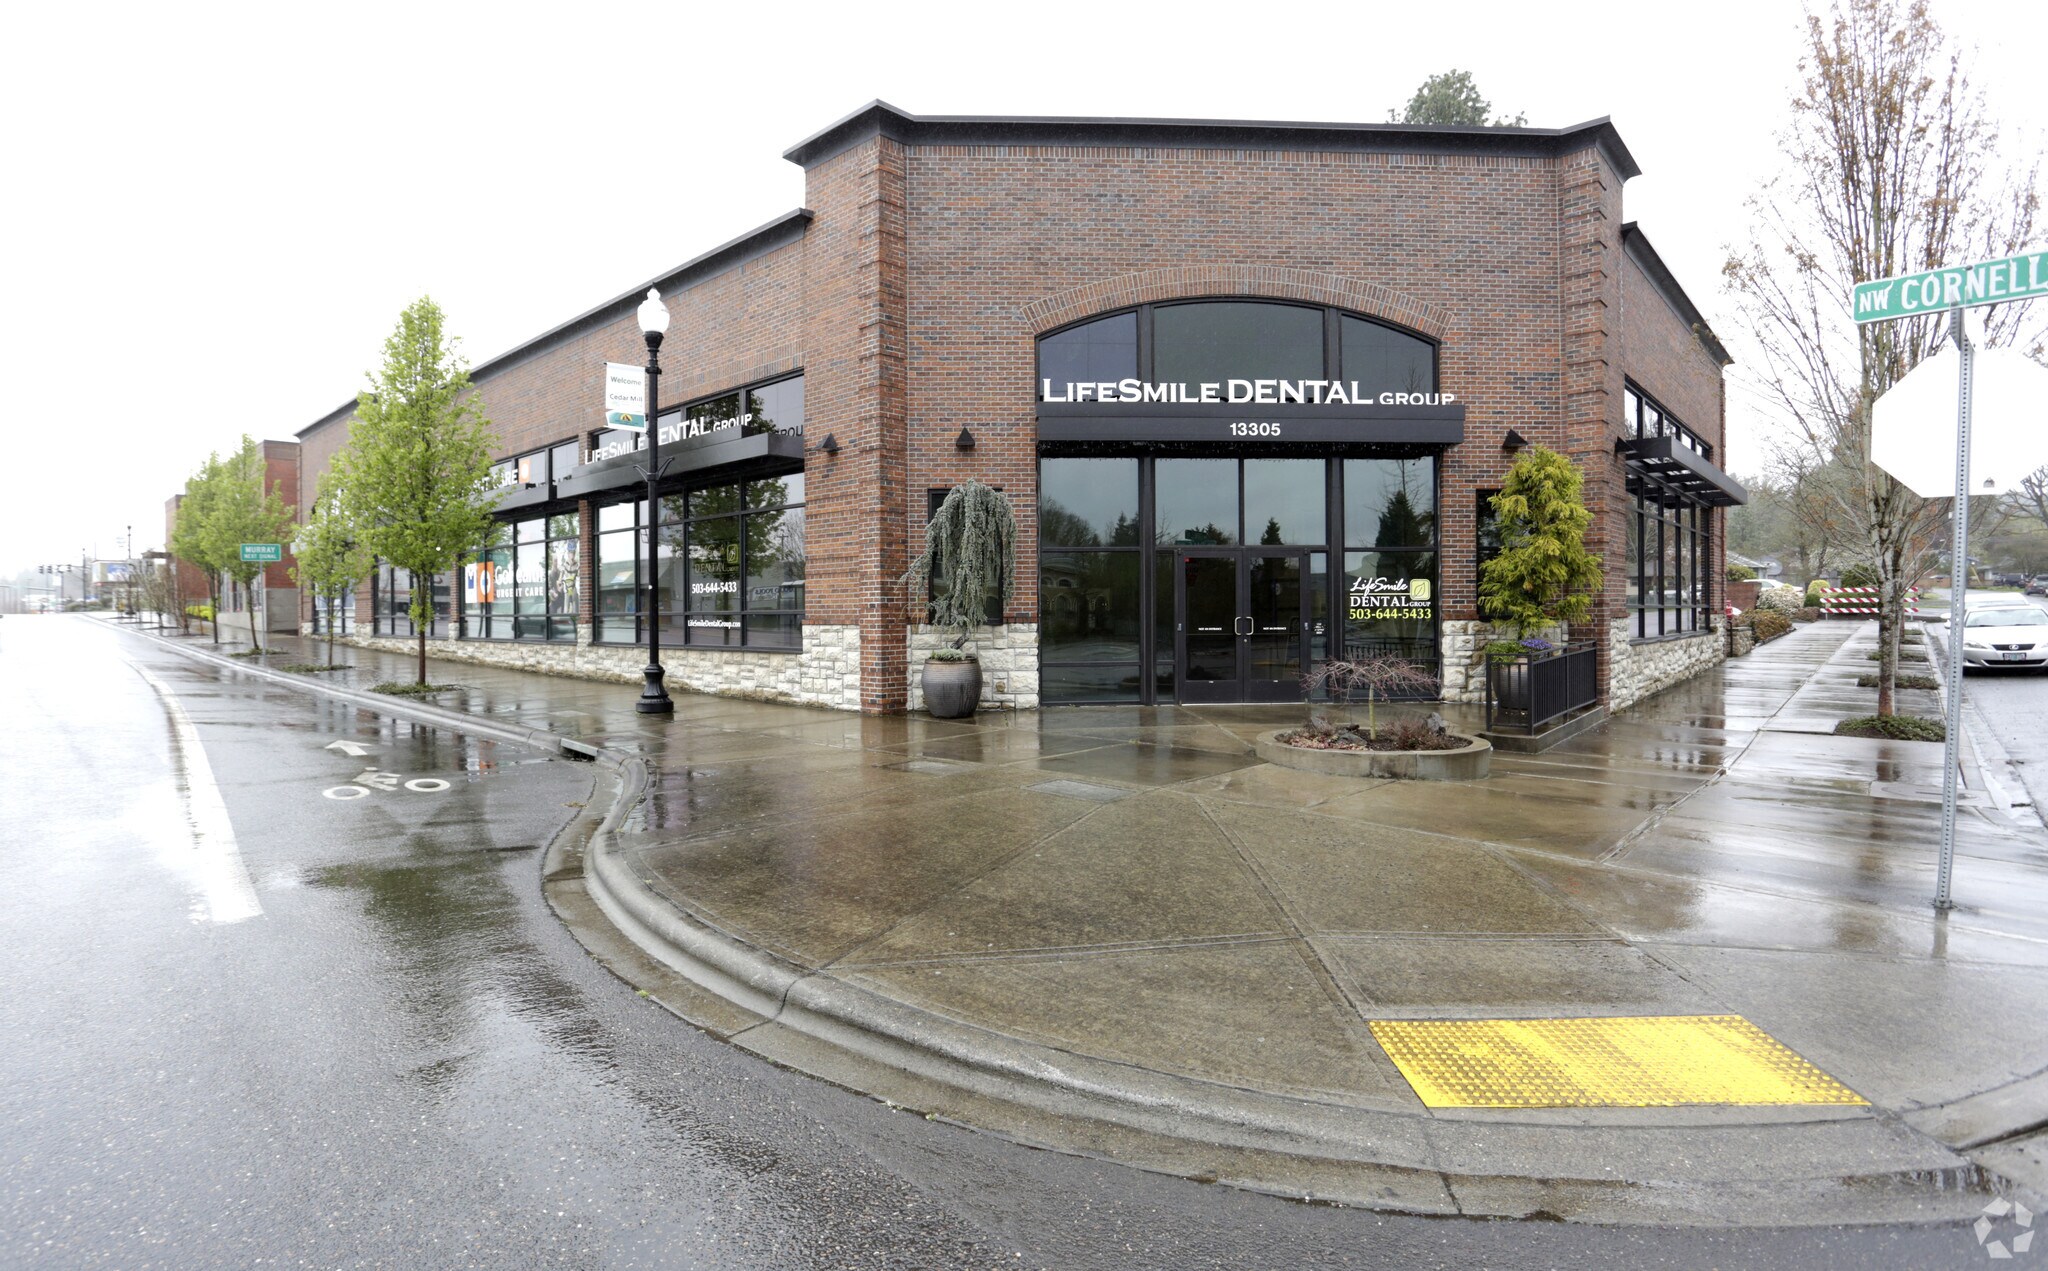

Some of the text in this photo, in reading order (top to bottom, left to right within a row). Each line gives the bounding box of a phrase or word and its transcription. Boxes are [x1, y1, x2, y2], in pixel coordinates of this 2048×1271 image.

[1859, 256, 2048, 313] NW CORNELL
[610, 376, 642, 386] Welcome
[1228, 379, 1373, 404] DENTAL
[1379, 392, 1455, 405] GROUP
[657, 416, 711, 446] ENTAL
[713, 414, 753, 432] GROUP
[1229, 422, 1281, 437] 13305
[525, 587, 544, 597] CARE
[692, 582, 737, 594] 503-644-5433
[1350, 577, 1408, 597] LifeSmile
[1350, 596, 1409, 607] DENTAL
[1349, 608, 1432, 619] 503-644-5433
